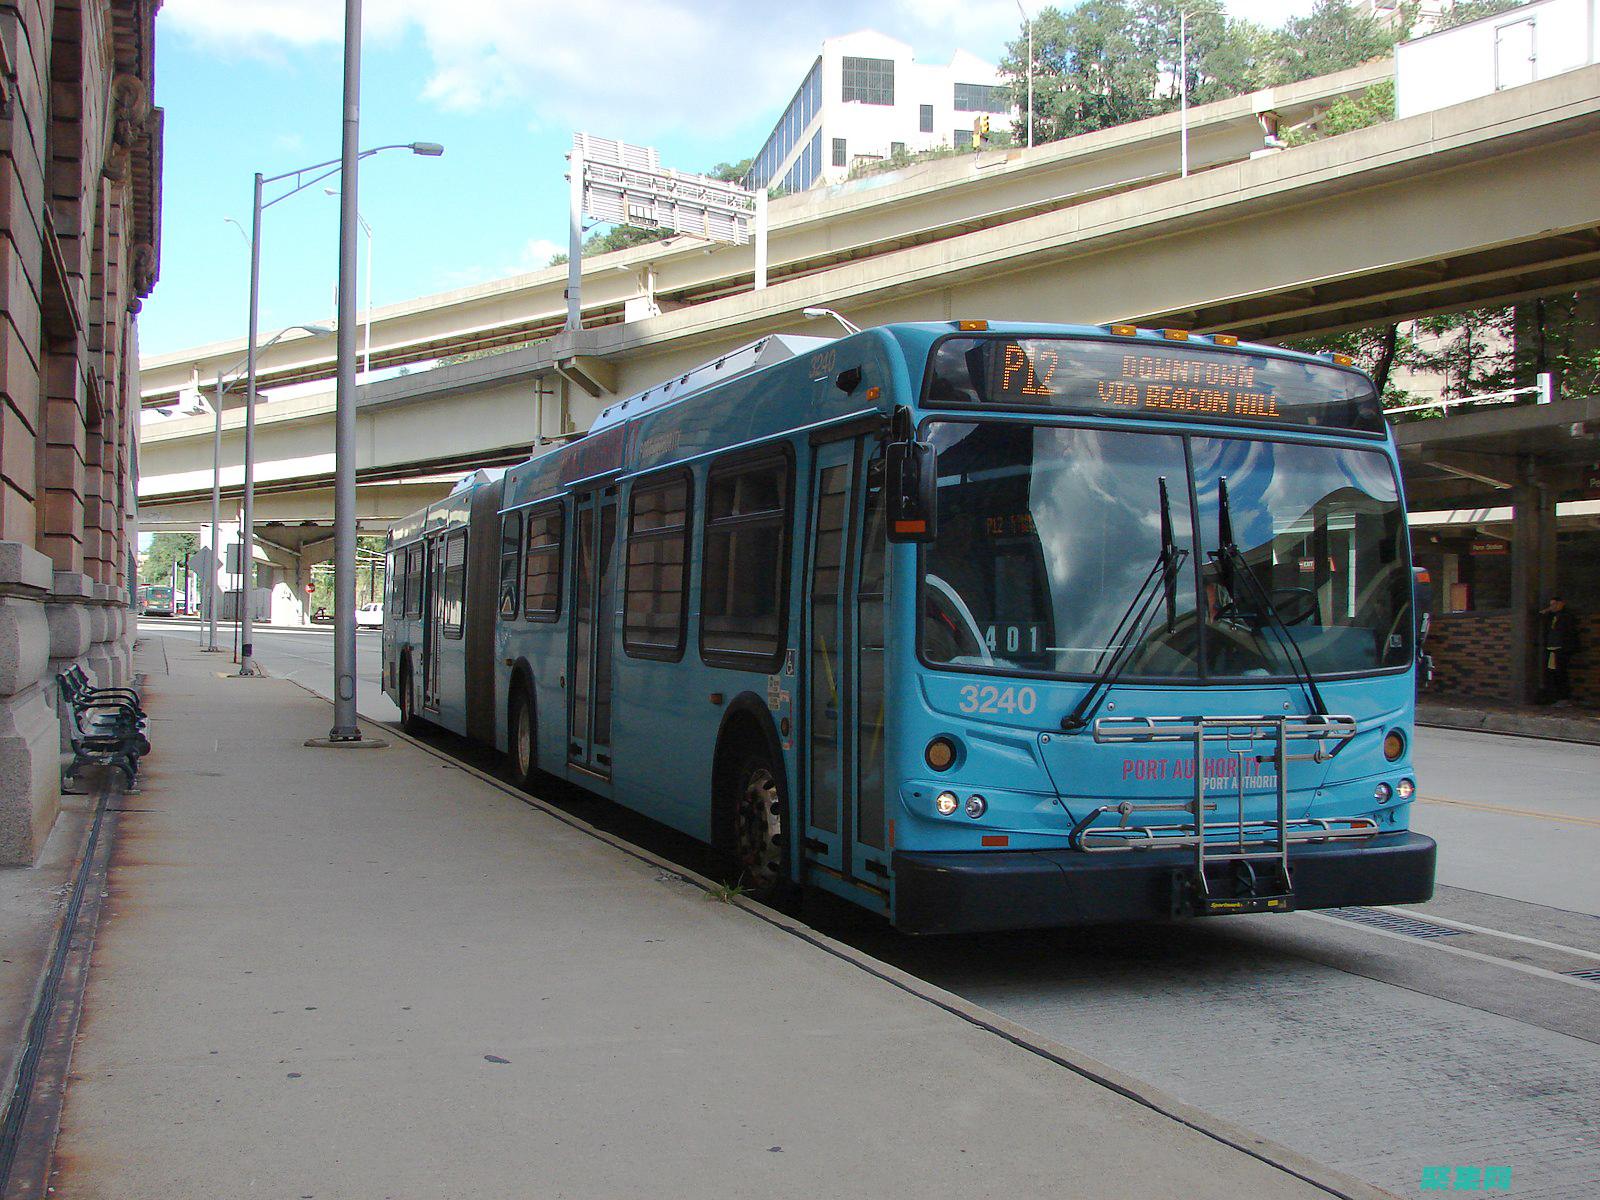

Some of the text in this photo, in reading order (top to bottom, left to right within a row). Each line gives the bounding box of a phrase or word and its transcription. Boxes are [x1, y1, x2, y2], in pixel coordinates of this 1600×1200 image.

[1003, 345, 1058, 395] P12
[1122, 355, 1254, 388] DOWNTOWN
[1098, 380, 1280, 417] VIA BEACON HILL
[985, 625, 1037, 652] 401
[959, 685, 1037, 714] 3240
[1123, 757, 1261, 780] PORT AUHORTY
[1203, 777, 1230, 790] PORT
